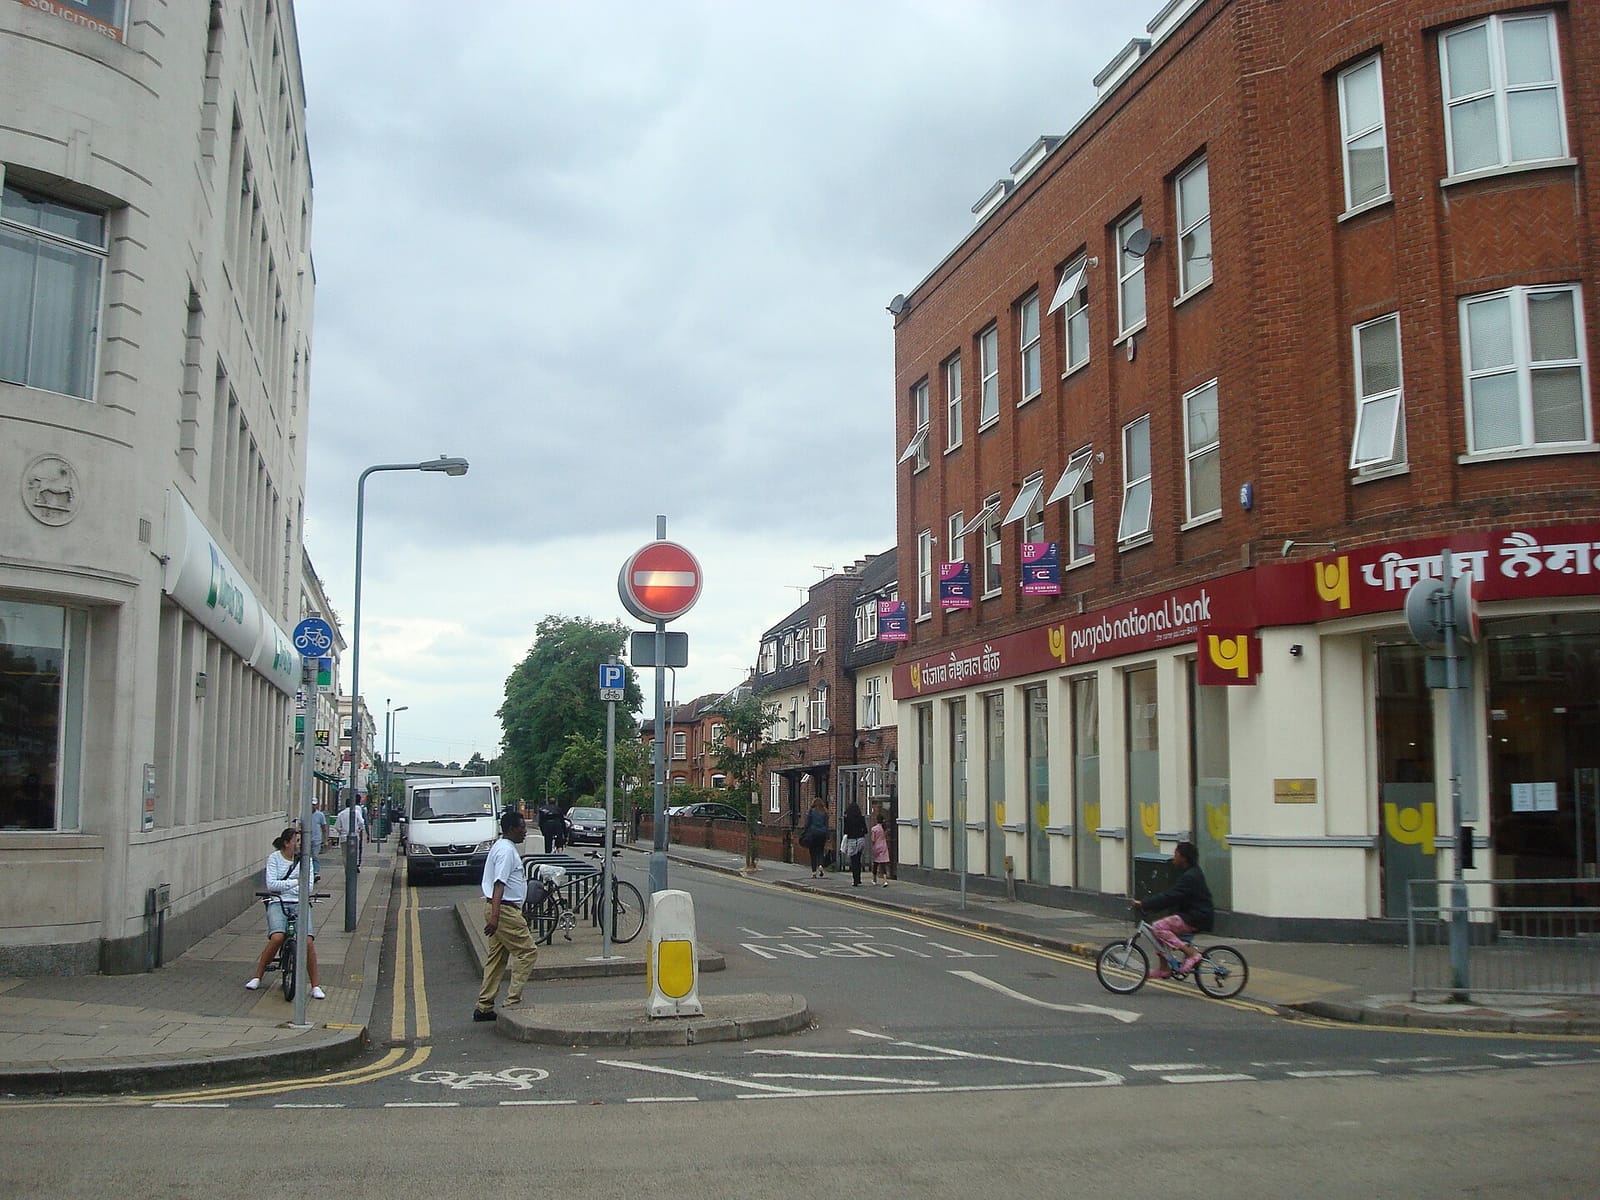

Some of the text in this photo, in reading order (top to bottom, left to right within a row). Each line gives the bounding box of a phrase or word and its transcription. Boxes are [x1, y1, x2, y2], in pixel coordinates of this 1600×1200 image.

[29, 0, 117, 40] SOLICITORS
[1071, 589, 1211, 658] punjab national bank
[605, 667, 620, 687] P
[921, 662, 947, 685] पंजाब
[736, 926, 928, 939] LEFT
[739, 942, 999, 959] TURN
